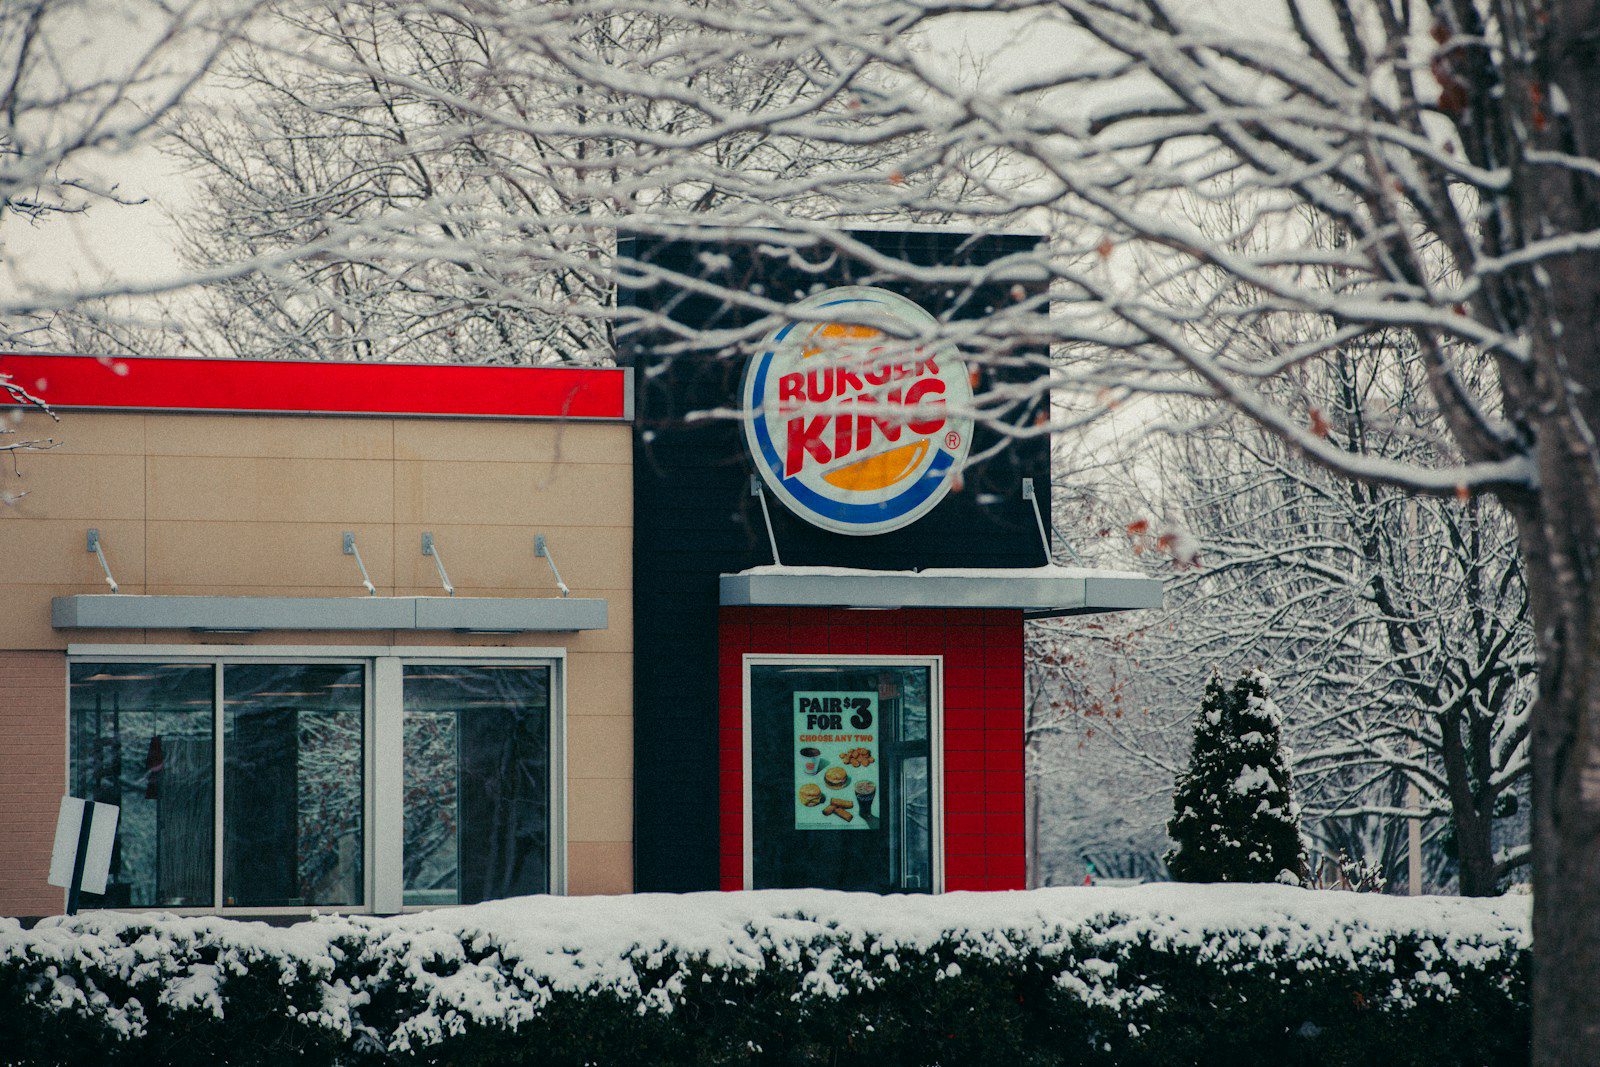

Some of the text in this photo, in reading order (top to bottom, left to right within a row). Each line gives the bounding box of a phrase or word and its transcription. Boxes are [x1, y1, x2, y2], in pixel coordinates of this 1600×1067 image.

[786, 378, 946, 477] KING
[799, 697, 873, 730] PAIR $3
[807, 714, 842, 730] FOR
[799, 734, 873, 742] CHOOSE ANY TWO
